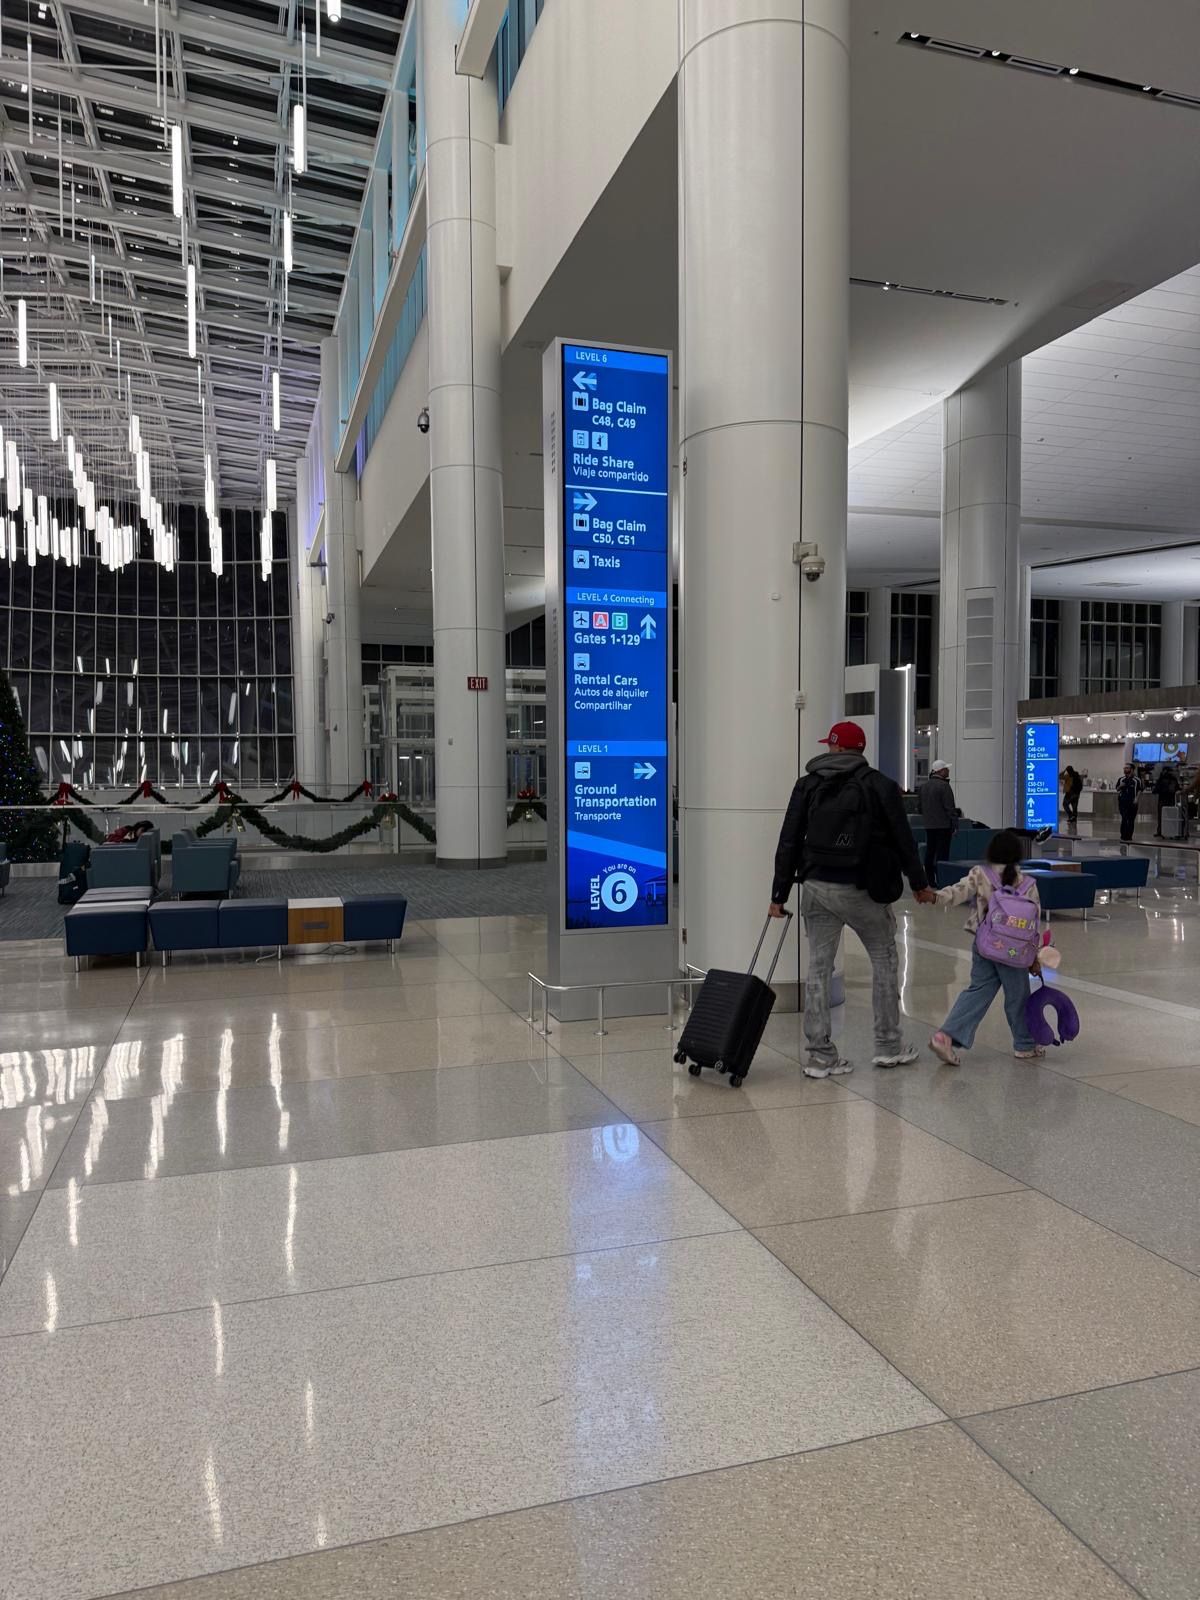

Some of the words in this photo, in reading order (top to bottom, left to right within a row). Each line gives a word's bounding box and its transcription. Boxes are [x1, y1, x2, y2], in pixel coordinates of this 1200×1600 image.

[575, 351, 600, 362] LEVEL
[602, 354, 608, 363] 6
[592, 397, 613, 414] Bag
[616, 401, 647, 415] Claim
[592, 415, 614, 428] C48,
[617, 418, 636, 429] C49
[573, 453, 599, 466] Ride
[602, 456, 635, 469] Share
[573, 466, 596, 479] Viaje
[598, 469, 649, 482] compartido
[592, 518, 613, 532] Bag
[616, 519, 647, 532] Claim
[592, 533, 614, 545] C50,
[617, 535, 635, 546] C51
[592, 555, 621, 568] Taxis
[577, 592, 602, 602] LEVEL
[603, 594, 609, 602] 4
[610, 594, 655, 606] Connecting
[596, 614, 608, 626] A
[615, 616, 624, 626] B
[574, 632, 607, 644] Gates
[610, 634, 641, 646] 1-129
[470, 678, 486, 689] EXIT
[574, 674, 611, 685] Rental
[614, 675, 639, 686] Cars
[574, 687, 601, 697] Autos
[602, 688, 614, 697] de
[615, 688, 649, 699] alquiler
[574, 700, 633, 712] Compartilhar
[578, 744, 602, 753] LEVEL
[604, 744, 609, 753] 1
[575, 784, 617, 795] Ground
[574, 795, 657, 809] Transportation
[574, 811, 622, 822] Transporte
[602, 864, 616, 874] You
[628, 865, 637, 874] on
[590, 874, 600, 911] LEVEL
[611, 879, 628, 905] 6
